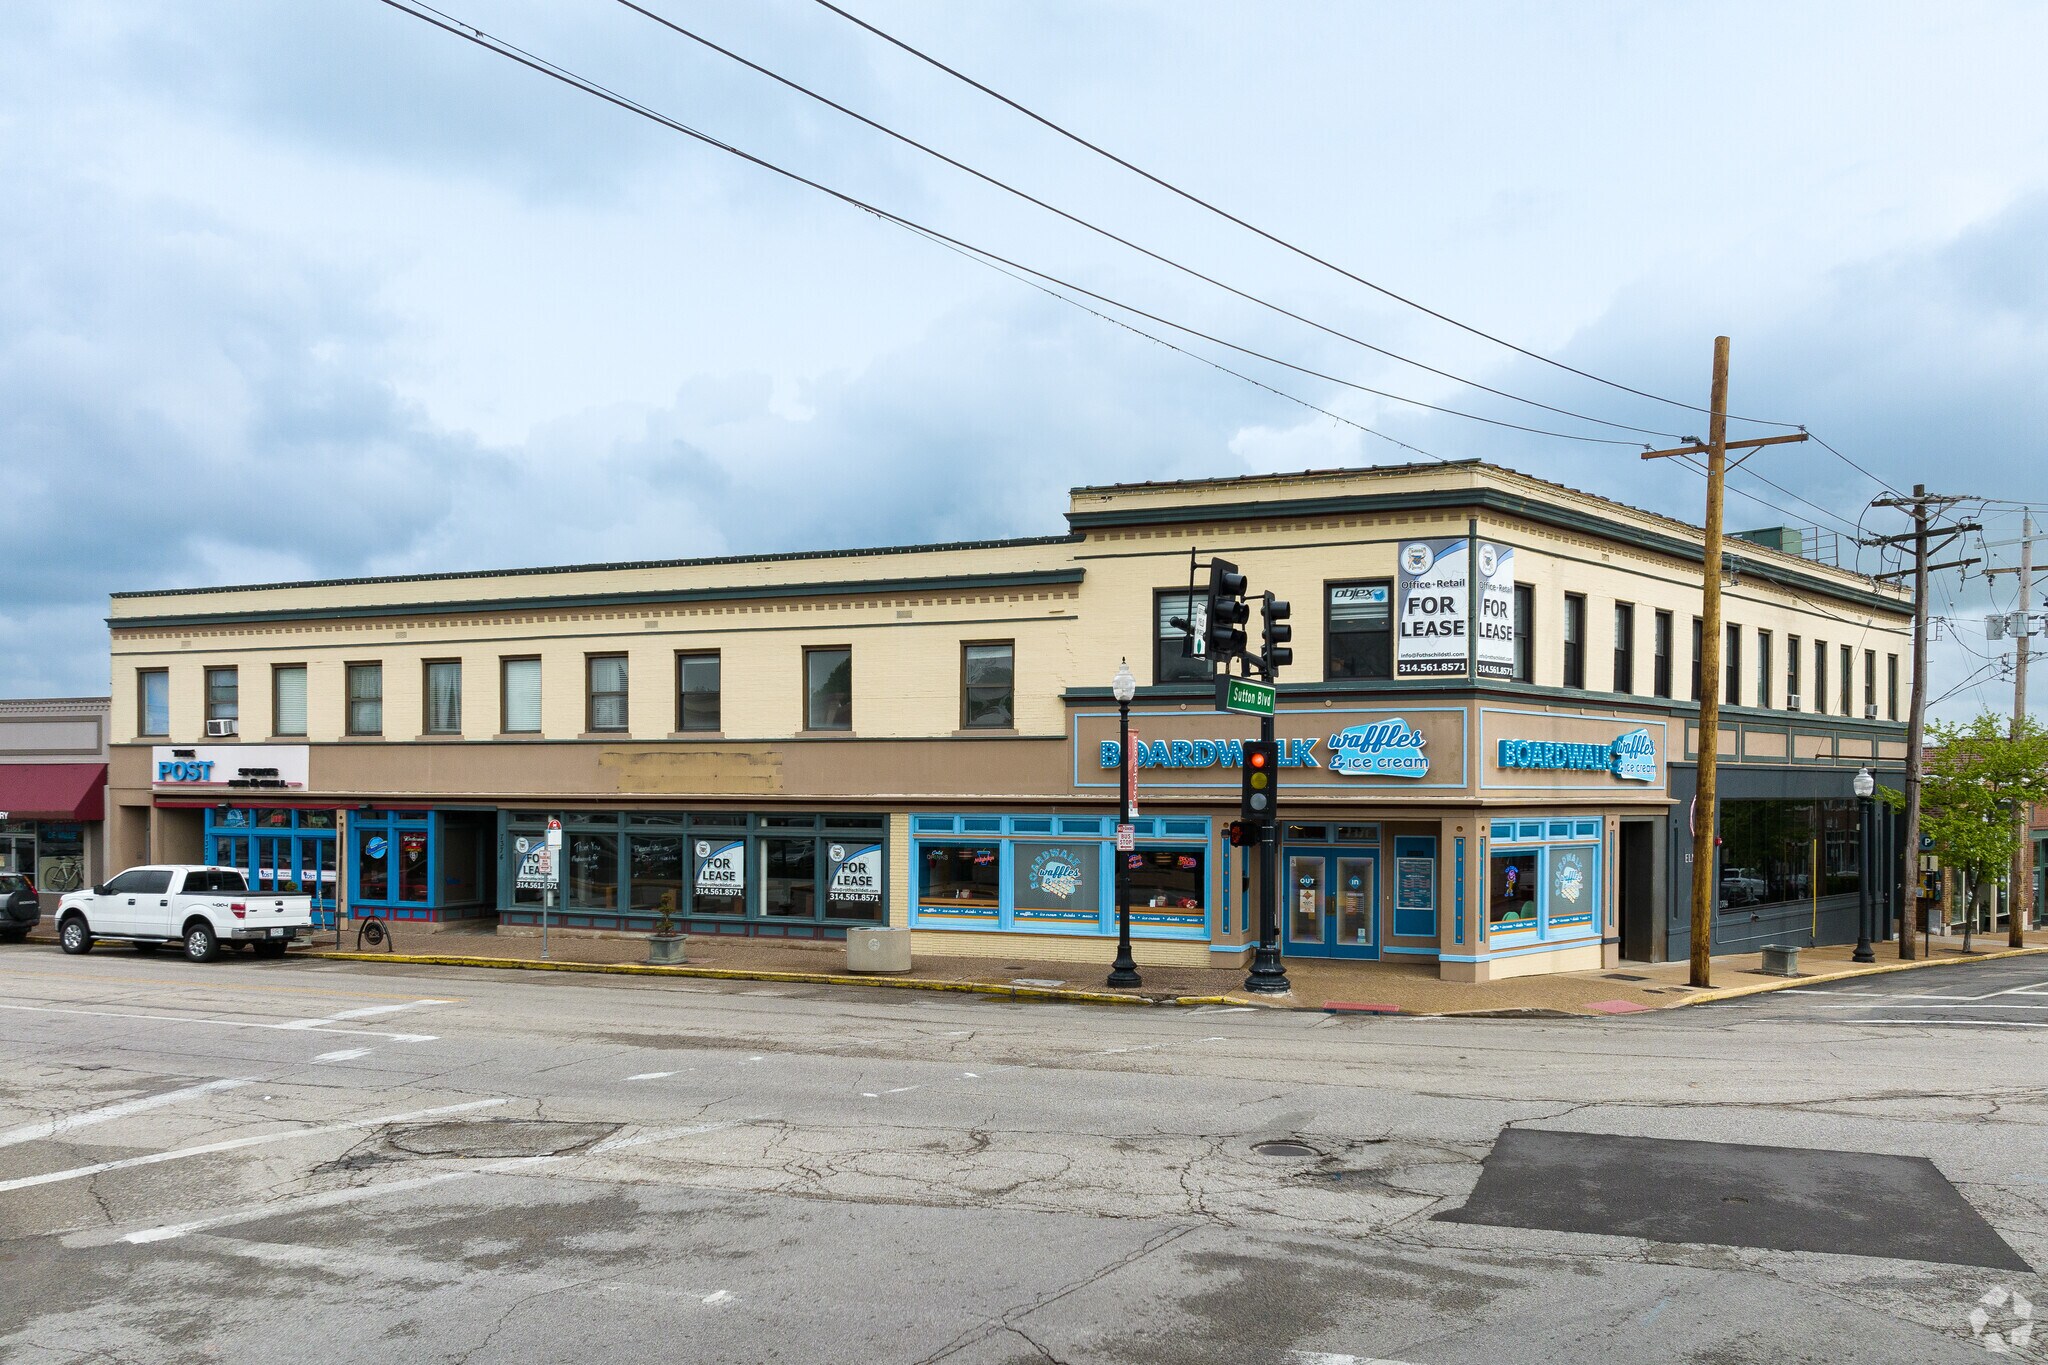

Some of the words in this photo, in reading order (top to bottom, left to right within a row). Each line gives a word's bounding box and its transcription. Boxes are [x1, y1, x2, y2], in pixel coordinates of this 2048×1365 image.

[1401, 581, 1431, 589] Office
[1436, 579, 1466, 588] Retail
[1480, 582, 1496, 591] Office
[1499, 585, 1513, 594] Retail
[1334, 588, 1376, 600] objex
[1408, 597, 1457, 615] FOR
[1483, 599, 1508, 619] FOR
[1401, 620, 1465, 637] LEASE
[1479, 622, 1513, 641] LEASE
[1399, 662, 1466, 673] 314.561.8571
[1478, 664, 1513, 676] 314.561.8571
[1233, 687, 1256, 704] Sutton
[1257, 691, 1271, 707] Blvd
[1328, 723, 1427, 755] waffles
[1100, 738, 1323, 768] BARDWLK
[1617, 735, 1656, 759] waffles
[1503, 740, 1613, 770] BOARDWALK
[1329, 755, 1347, 769] &
[1348, 757, 1373, 770] ice
[1376, 757, 1430, 770] cream
[1625, 762, 1634, 772] ice
[1636, 763, 1657, 774] cream
[158, 761, 215, 782] POST
[1924, 838, 1931, 846] P
[526, 854, 540, 863] FO
[707, 858, 731, 868] FOR
[841, 862, 867, 873] FOR
[1029, 848, 1081, 889] BOARDWALK
[1039, 865, 1080, 878] waffles
[703, 871, 736, 880] LEASE
[837, 875, 873, 886] LEASE
[695, 888, 742, 896] 314.561.8571
[829, 893, 880, 902] 314.561.8571
